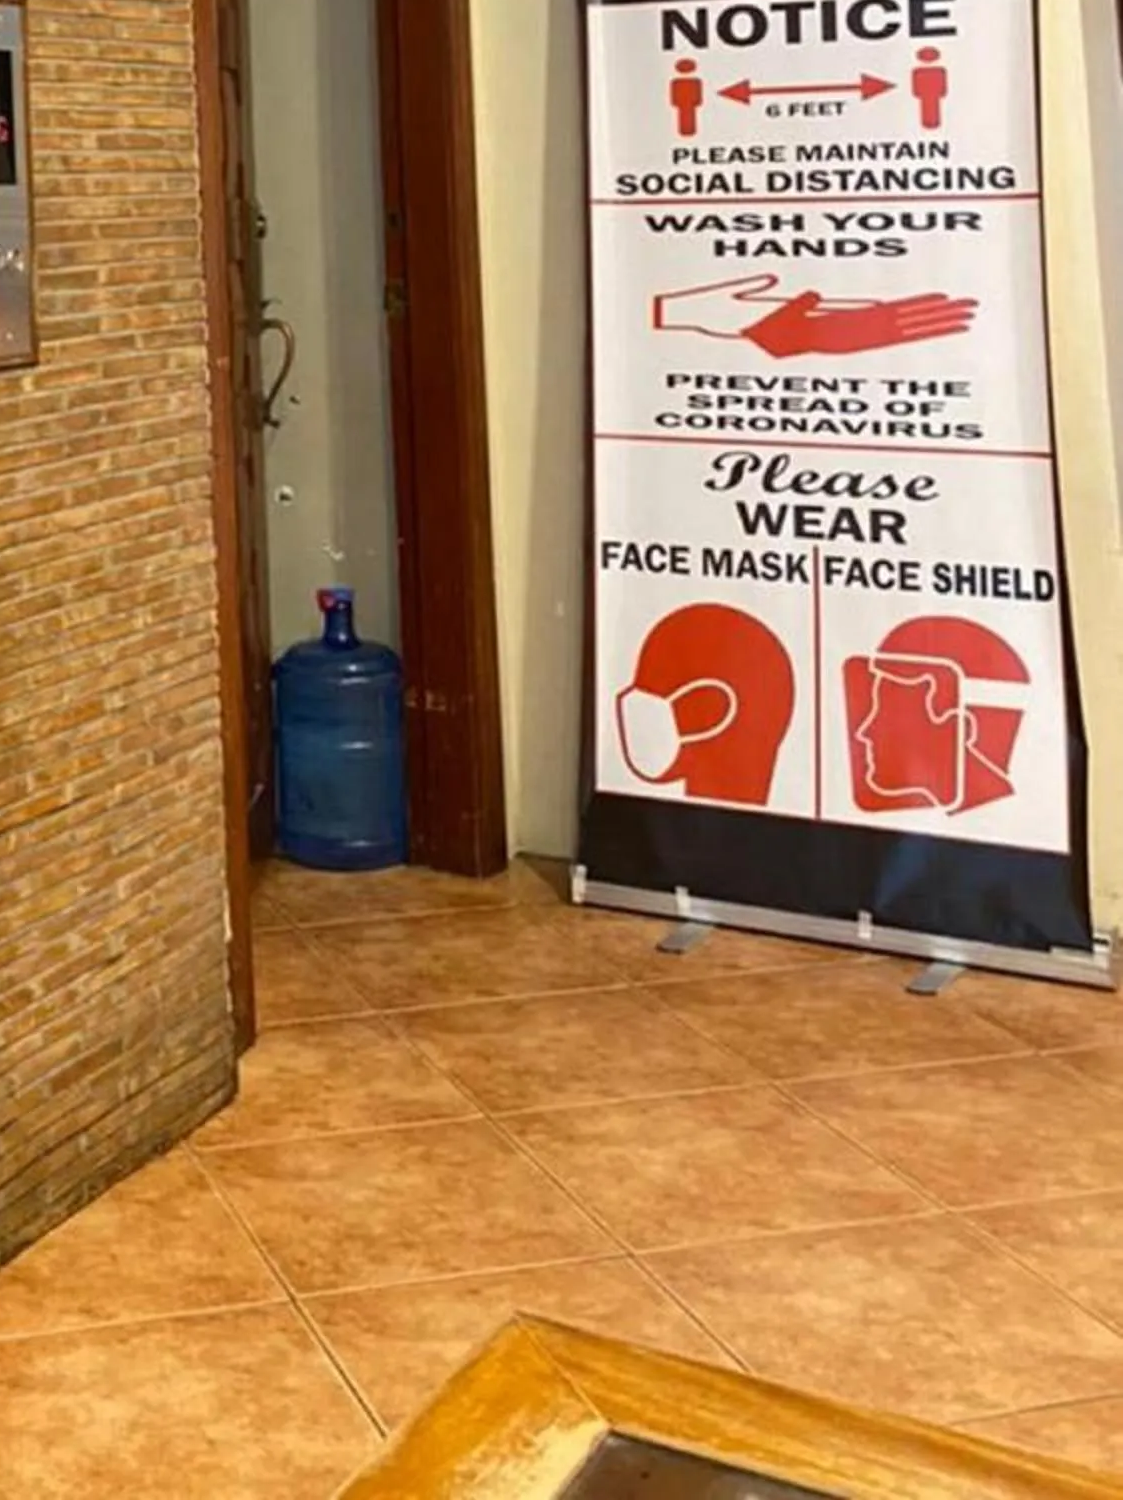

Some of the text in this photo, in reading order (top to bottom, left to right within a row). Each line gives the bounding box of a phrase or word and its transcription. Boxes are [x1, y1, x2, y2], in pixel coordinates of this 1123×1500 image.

[787, 101, 846, 118] FEET
[672, 141, 950, 166] PLEASE MAINTAIN
[615, 166, 1016, 197] SOCIAL DISTANCING
[645, 211, 983, 233] WASH YOUR
[713, 238, 910, 258] HANDS
[665, 373, 972, 397] PREVENT THE
[687, 394, 947, 417] SPREAD OF
[654, 412, 985, 440] CORONAVIRUS
[703, 450, 941, 502] Please
[735, 501, 909, 545] WEAR
[600, 541, 811, 584] FACE MASK
[823, 555, 1055, 602] FACE SHIELD
